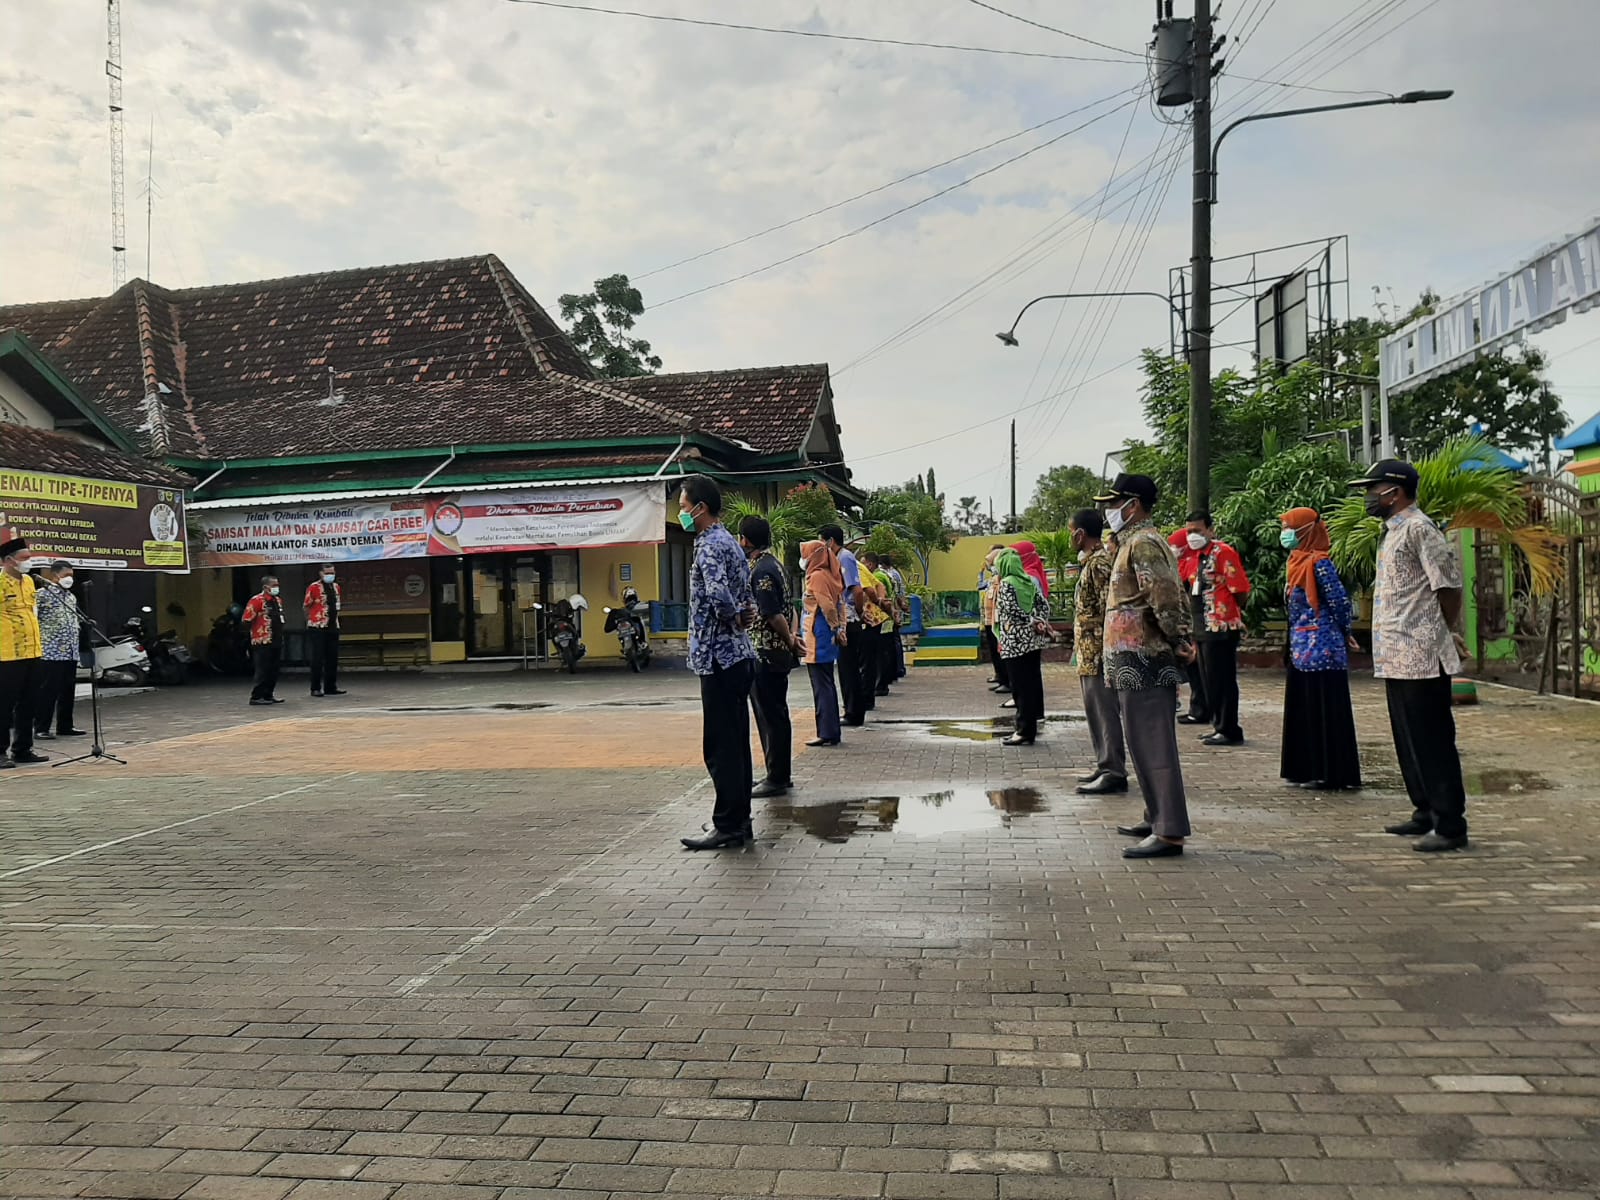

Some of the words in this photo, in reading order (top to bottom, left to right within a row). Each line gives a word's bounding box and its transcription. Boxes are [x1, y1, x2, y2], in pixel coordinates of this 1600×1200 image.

[48, 479, 134, 503] TIPE-TIPENYA
[313, 508, 354, 520] Kembali
[567, 502, 616, 513] Persatuan
[207, 526, 250, 540] SAMSAT
[252, 523, 292, 538] MALAM
[294, 523, 317, 536] DAN
[319, 521, 364, 534] SAMSAT
[367, 517, 390, 531] CAR
[393, 516, 423, 529] FREE
[216, 540, 269, 553] DIHALAMAN
[271, 538, 308, 550] KANTOR
[311, 536, 349, 548] SAMSAT
[350, 535, 384, 546] DEMAK
